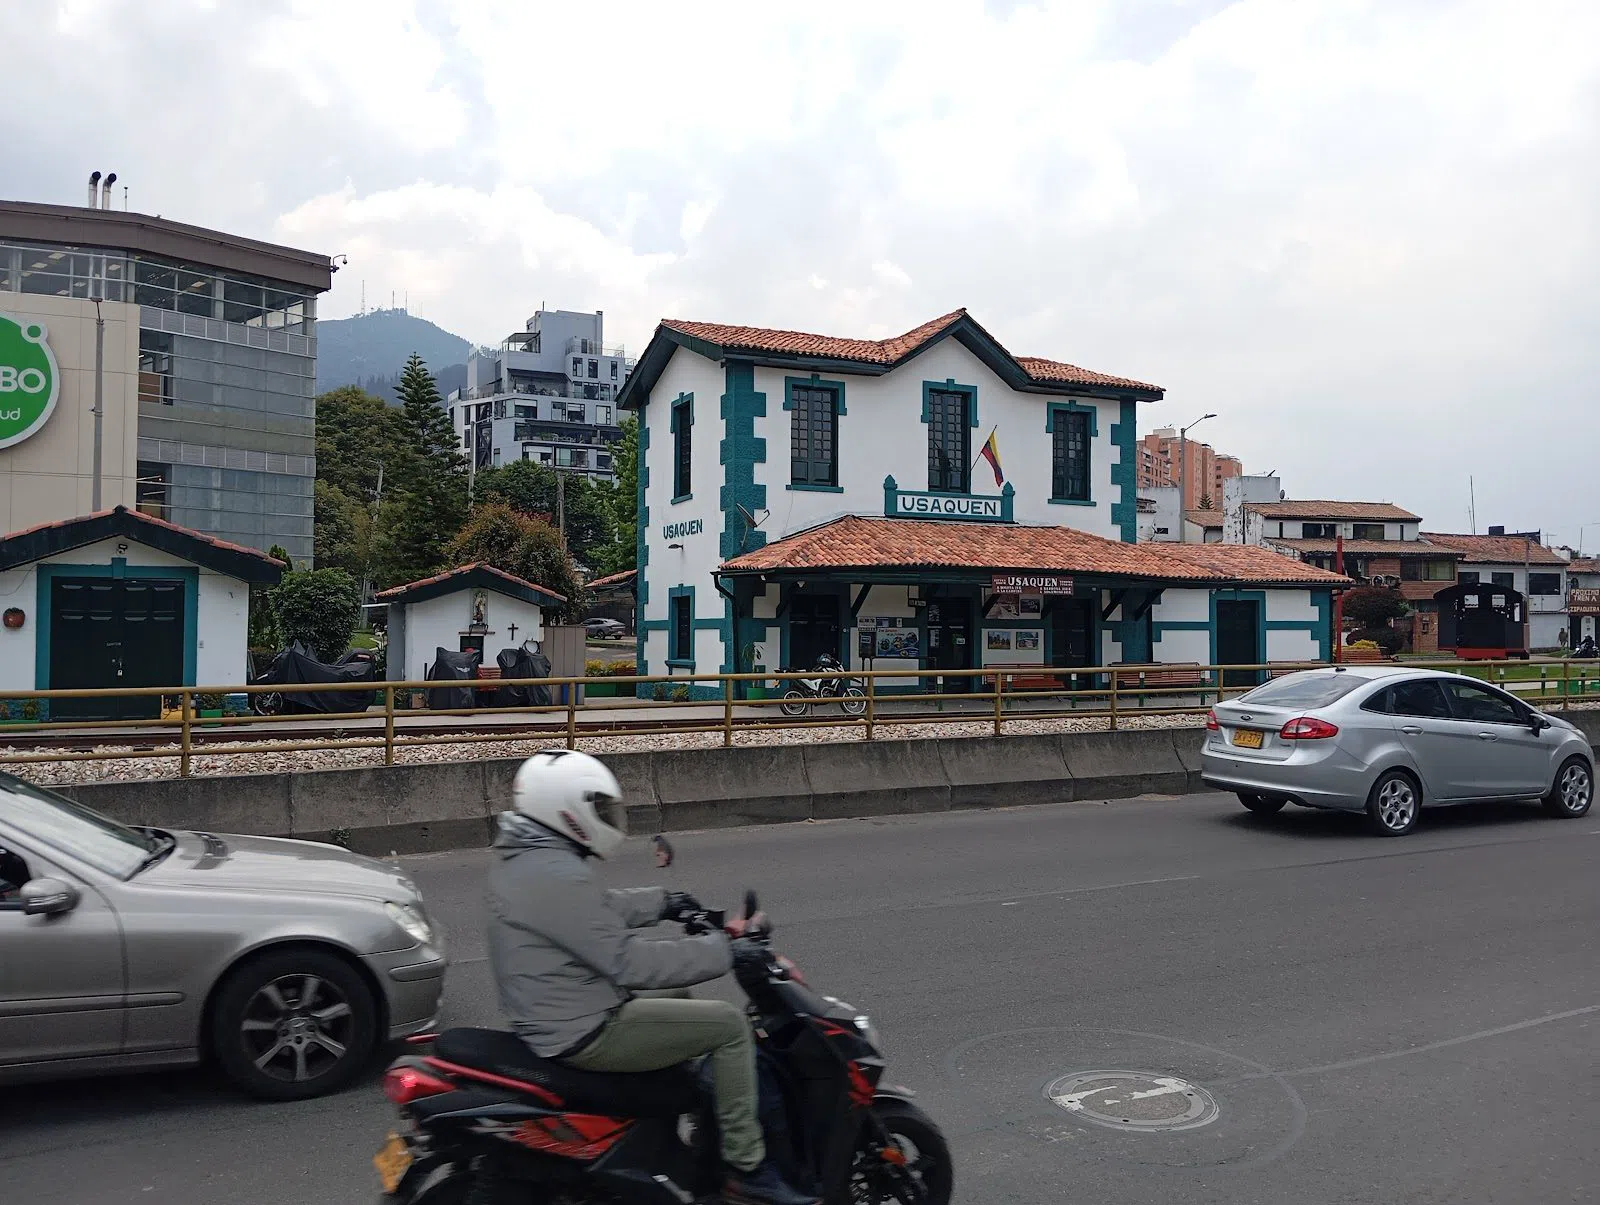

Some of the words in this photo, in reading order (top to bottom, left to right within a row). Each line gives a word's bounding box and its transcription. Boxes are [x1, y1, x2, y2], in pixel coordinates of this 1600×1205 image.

[902, 496, 997, 516] USAQUEN
[663, 518, 703, 540] USAQUEN
[1007, 576, 1058, 588] USAQUEN
